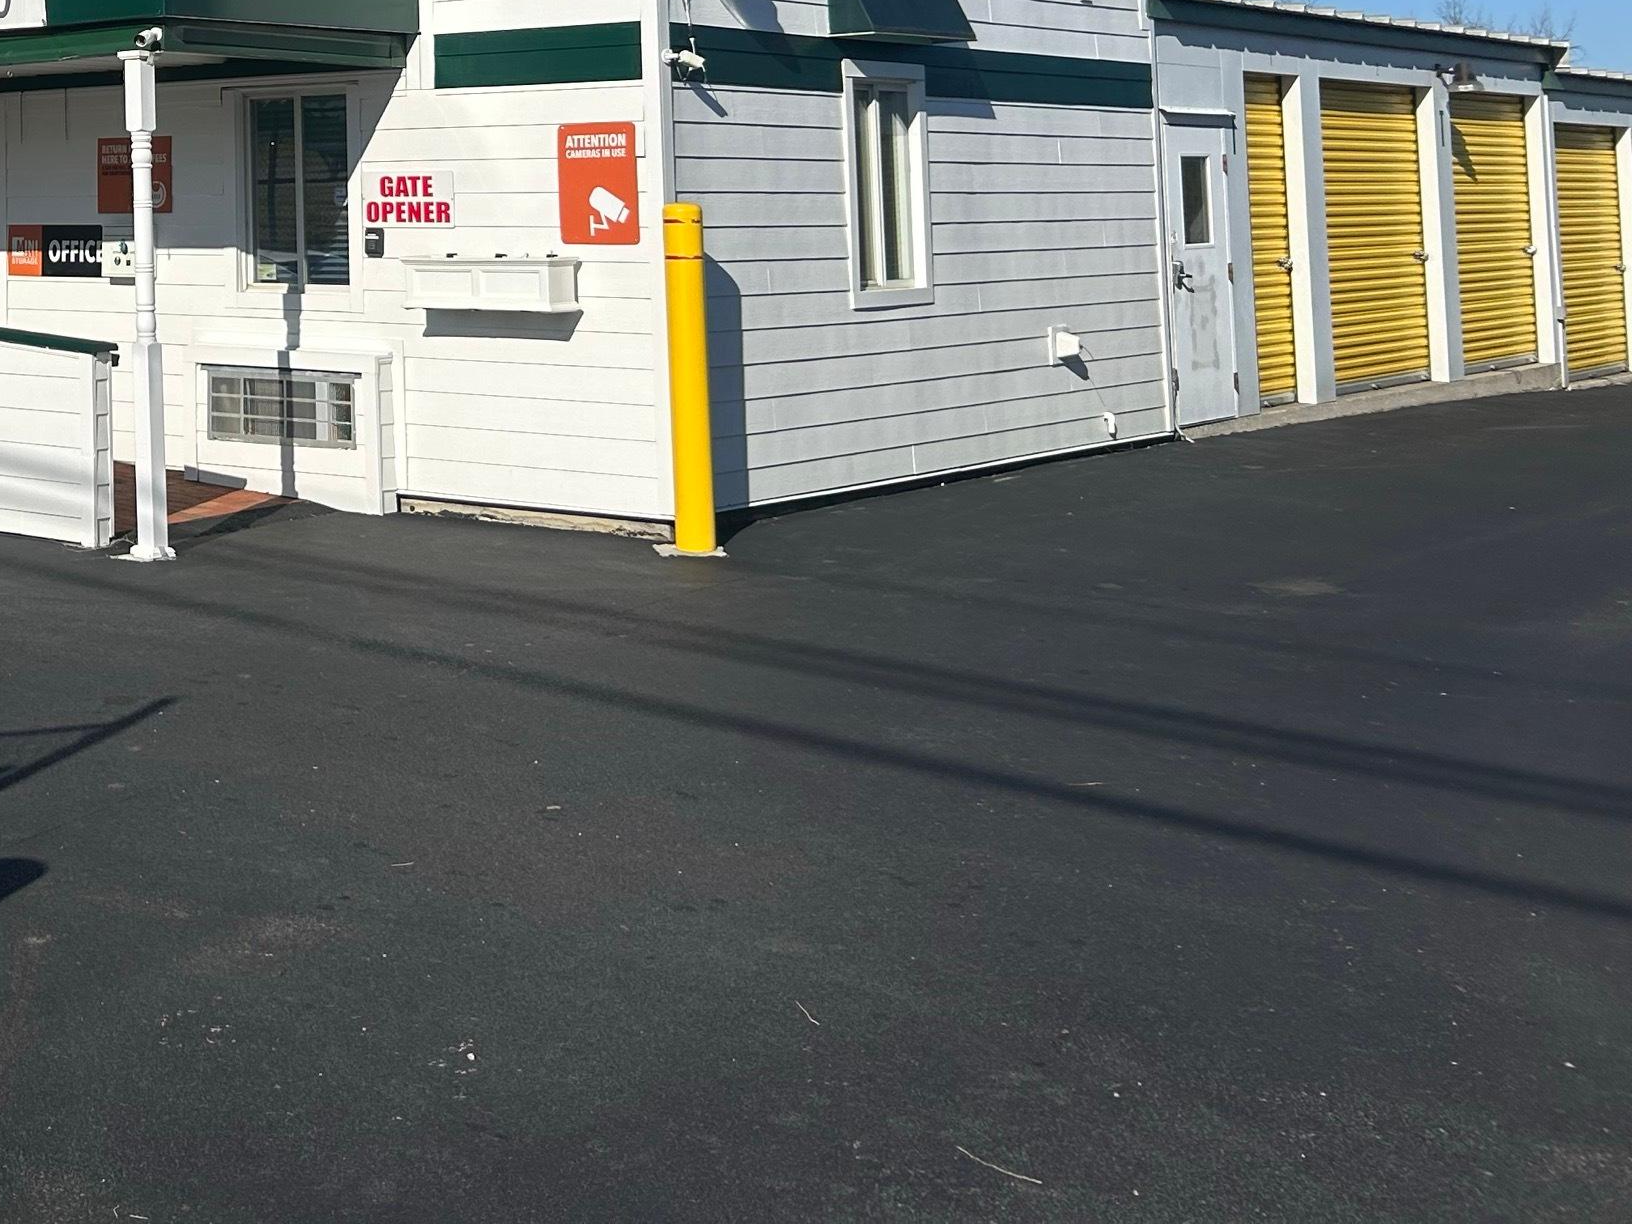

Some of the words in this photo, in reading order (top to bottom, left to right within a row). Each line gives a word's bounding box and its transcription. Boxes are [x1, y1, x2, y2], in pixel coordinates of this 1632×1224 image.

[565, 133, 627, 149] ATTENTION
[565, 149, 601, 159] CAMERAS
[602, 148, 611, 158] IN
[612, 147, 626, 157] USE
[379, 175, 434, 197] GATE
[366, 201, 451, 224] OPENER
[48, 239, 102, 263] OFFICE
